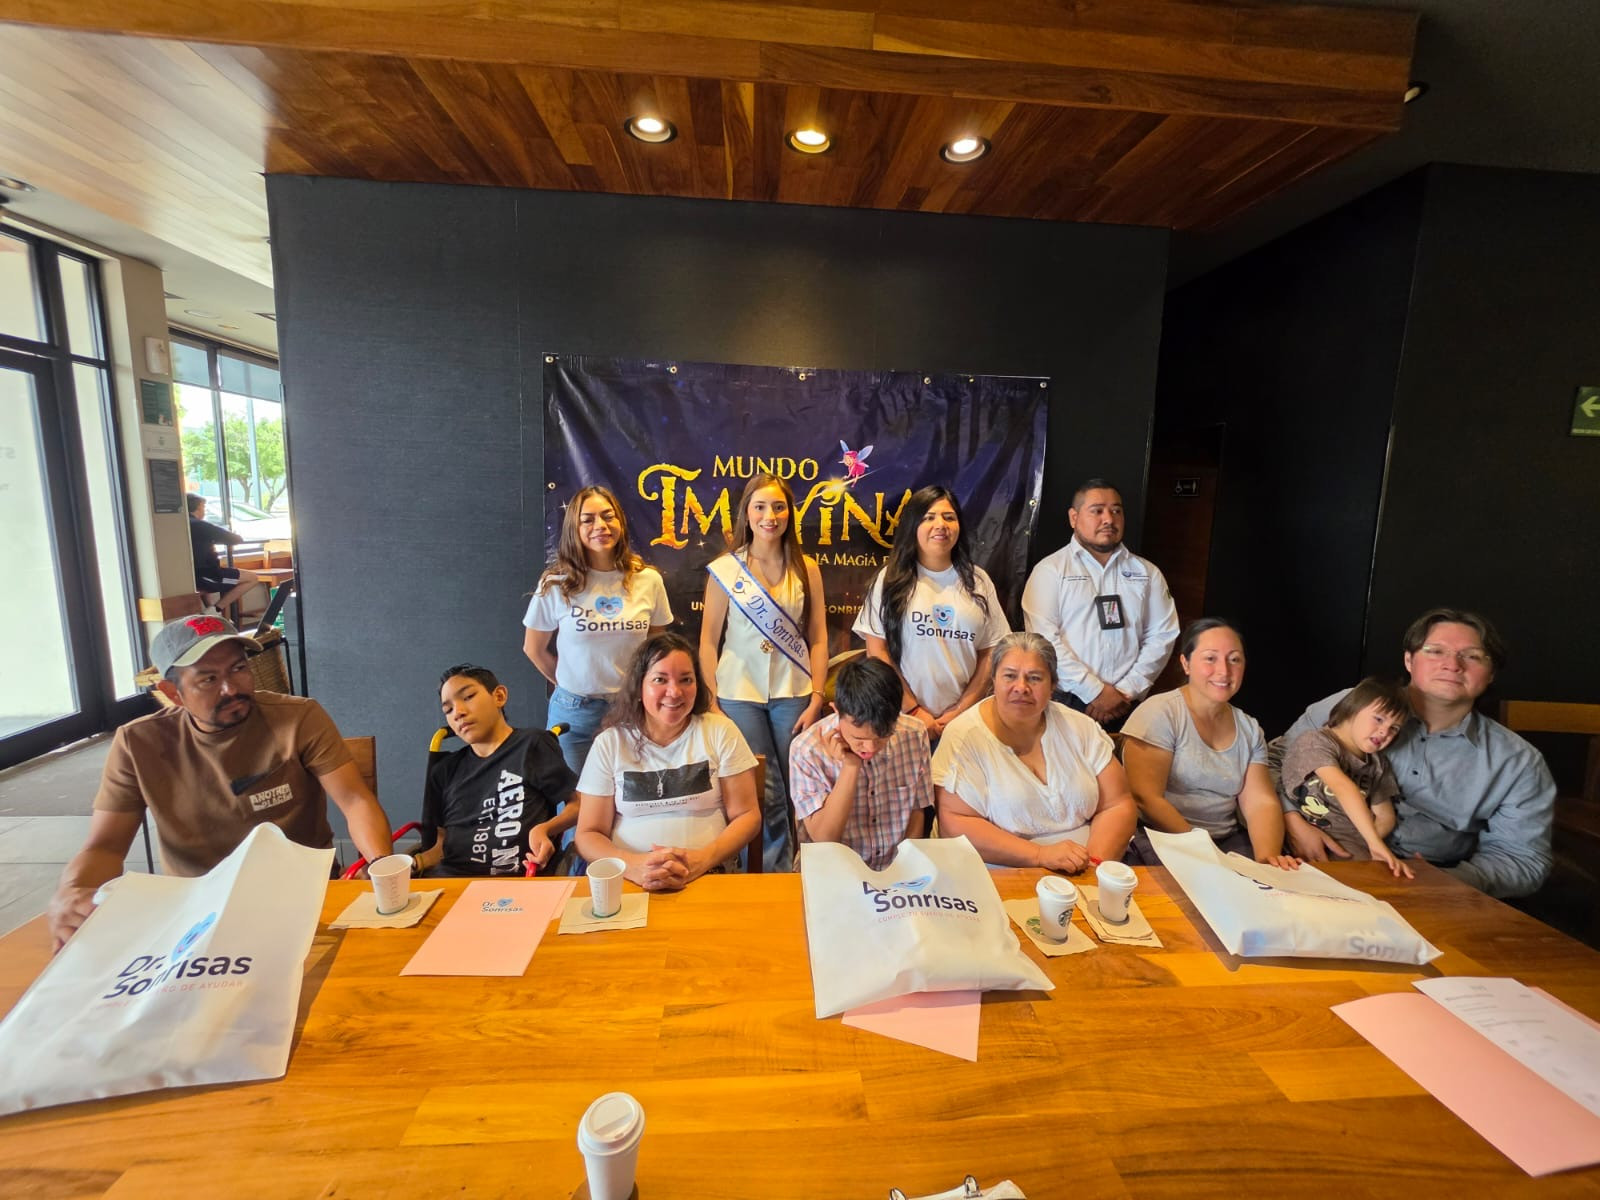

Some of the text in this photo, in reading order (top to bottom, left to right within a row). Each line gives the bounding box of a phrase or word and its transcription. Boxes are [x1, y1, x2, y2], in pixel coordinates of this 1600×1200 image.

[712, 454, 819, 481] MUNDO
[571, 605, 596, 618] Dr.
[911, 611, 933, 623] Dr.
[575, 618, 648, 632] Sonrisas
[747, 594, 806, 658] Dr. Sonrisas
[916, 624, 976, 642] Sonrisas
[470, 826, 491, 863] 1987
[873, 889, 979, 914] Sonrisas
[117, 955, 167, 978] Dr.
